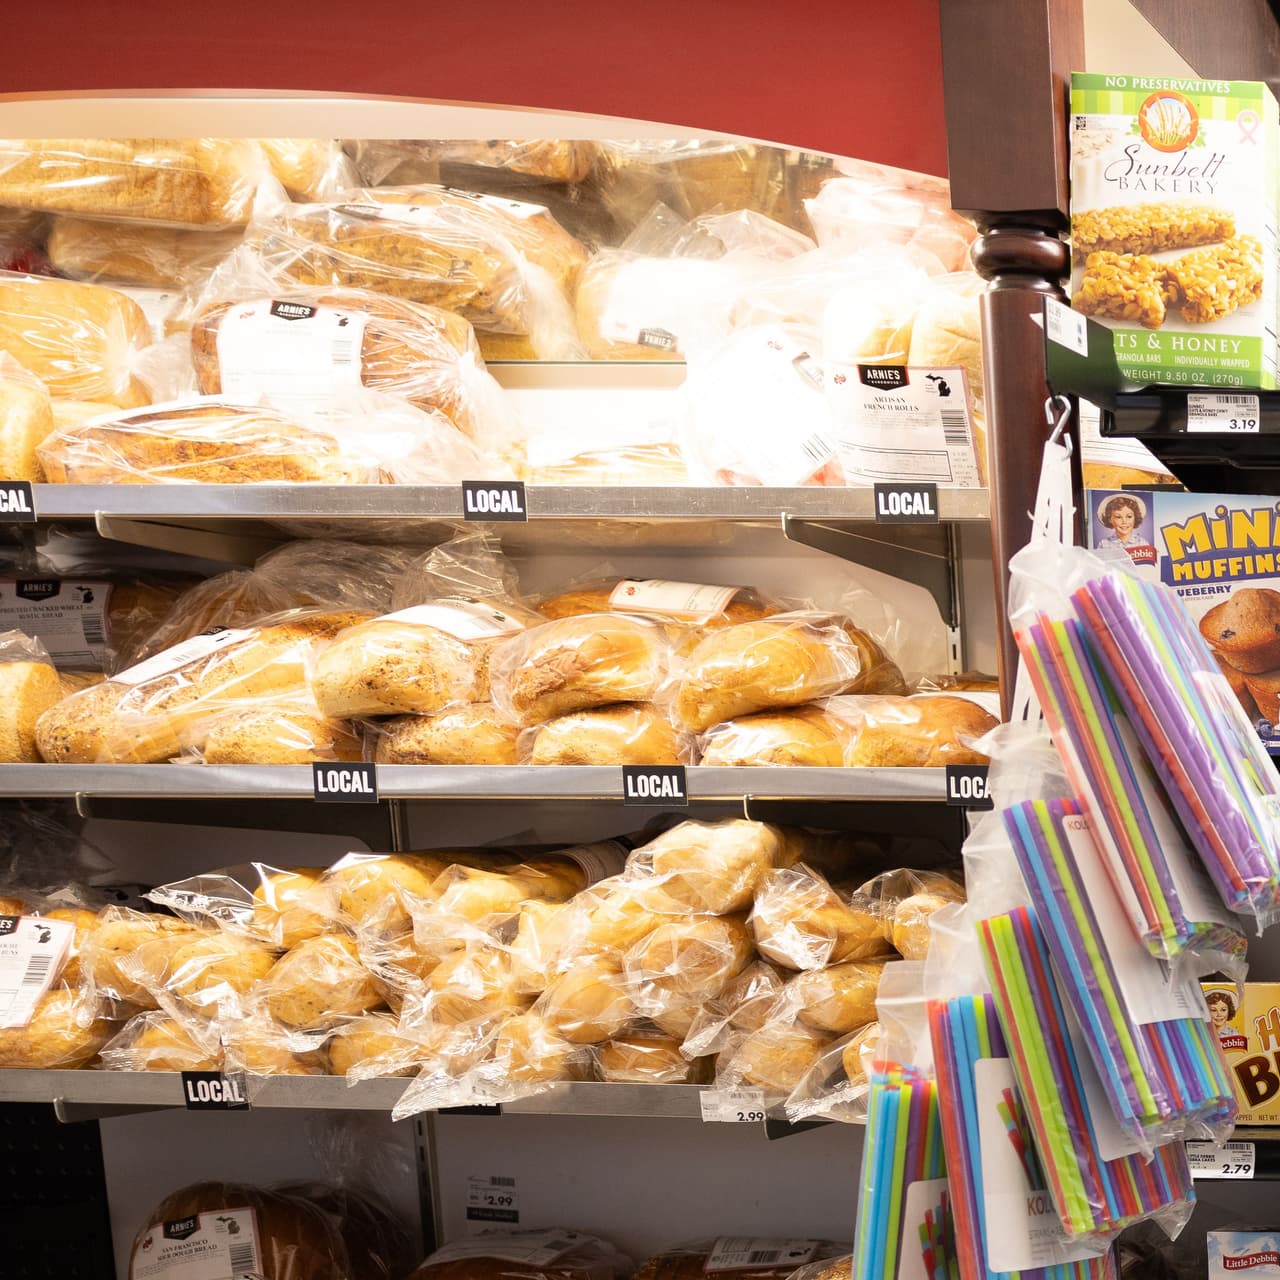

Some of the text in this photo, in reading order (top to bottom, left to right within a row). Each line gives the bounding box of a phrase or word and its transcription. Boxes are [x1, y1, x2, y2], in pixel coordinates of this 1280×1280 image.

[1104, 143, 1227, 182] Sunbelt
[1118, 176, 1218, 196] BAKERY
[866, 368, 901, 380] ARNIE'S
[1229, 418, 1256, 430] 3.19
[466, 489, 523, 513] LOCAL
[879, 493, 935, 515] LOCAL
[317, 769, 374, 795] LOCAL
[627, 774, 684, 799] LOCAL
[186, 1078, 245, 1103] LOCAL
